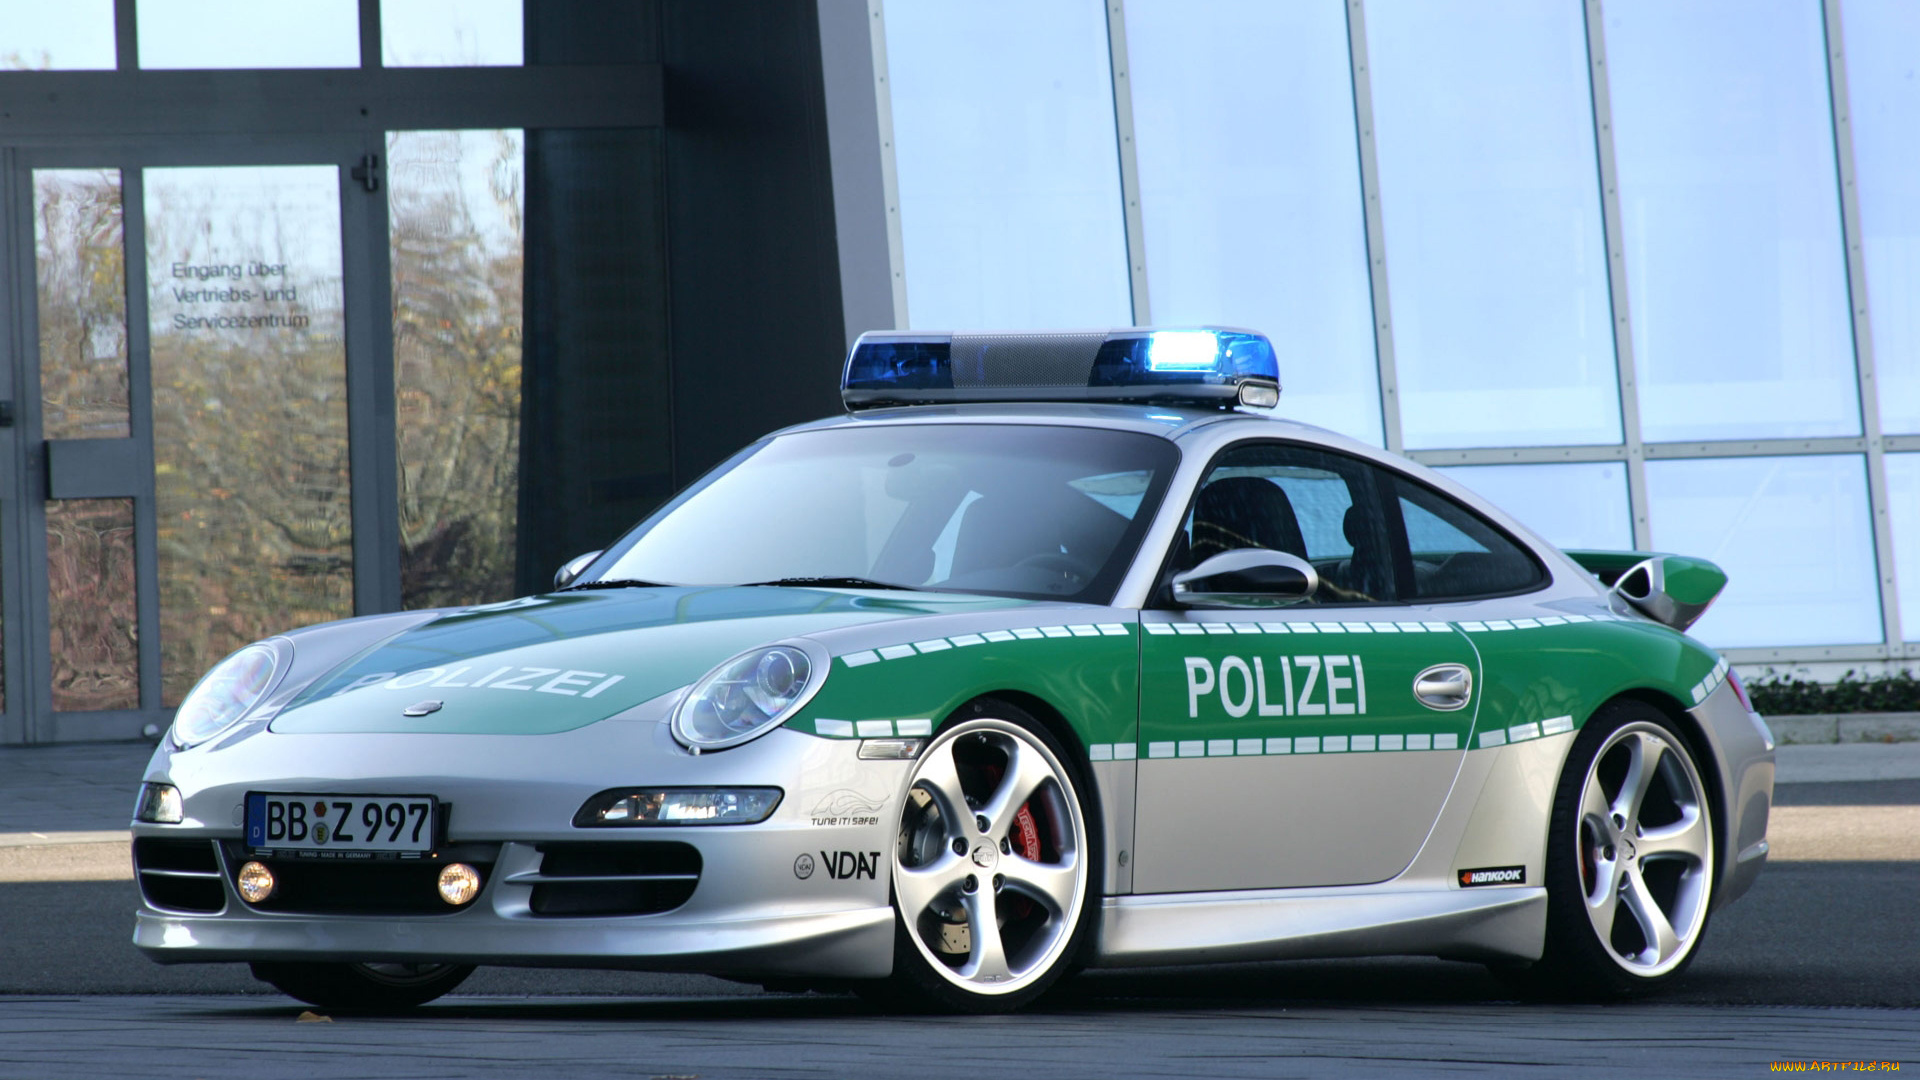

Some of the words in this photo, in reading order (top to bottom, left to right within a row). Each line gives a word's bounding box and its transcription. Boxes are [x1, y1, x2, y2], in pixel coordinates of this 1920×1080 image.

[171, 261, 242, 281] Eingang
[248, 260, 288, 277] über
[173, 285, 259, 302] Vertriebs-
[263, 285, 297, 301] und
[174, 313, 310, 330] Servicezentrum
[332, 666, 625, 699] POLIZEI
[1184, 655, 1367, 718] POLIZEI
[253, 826, 260, 838] D
[267, 801, 308, 841] BB
[332, 802, 353, 842] Z
[362, 802, 429, 843] 997
[820, 851, 881, 879] VDAT
